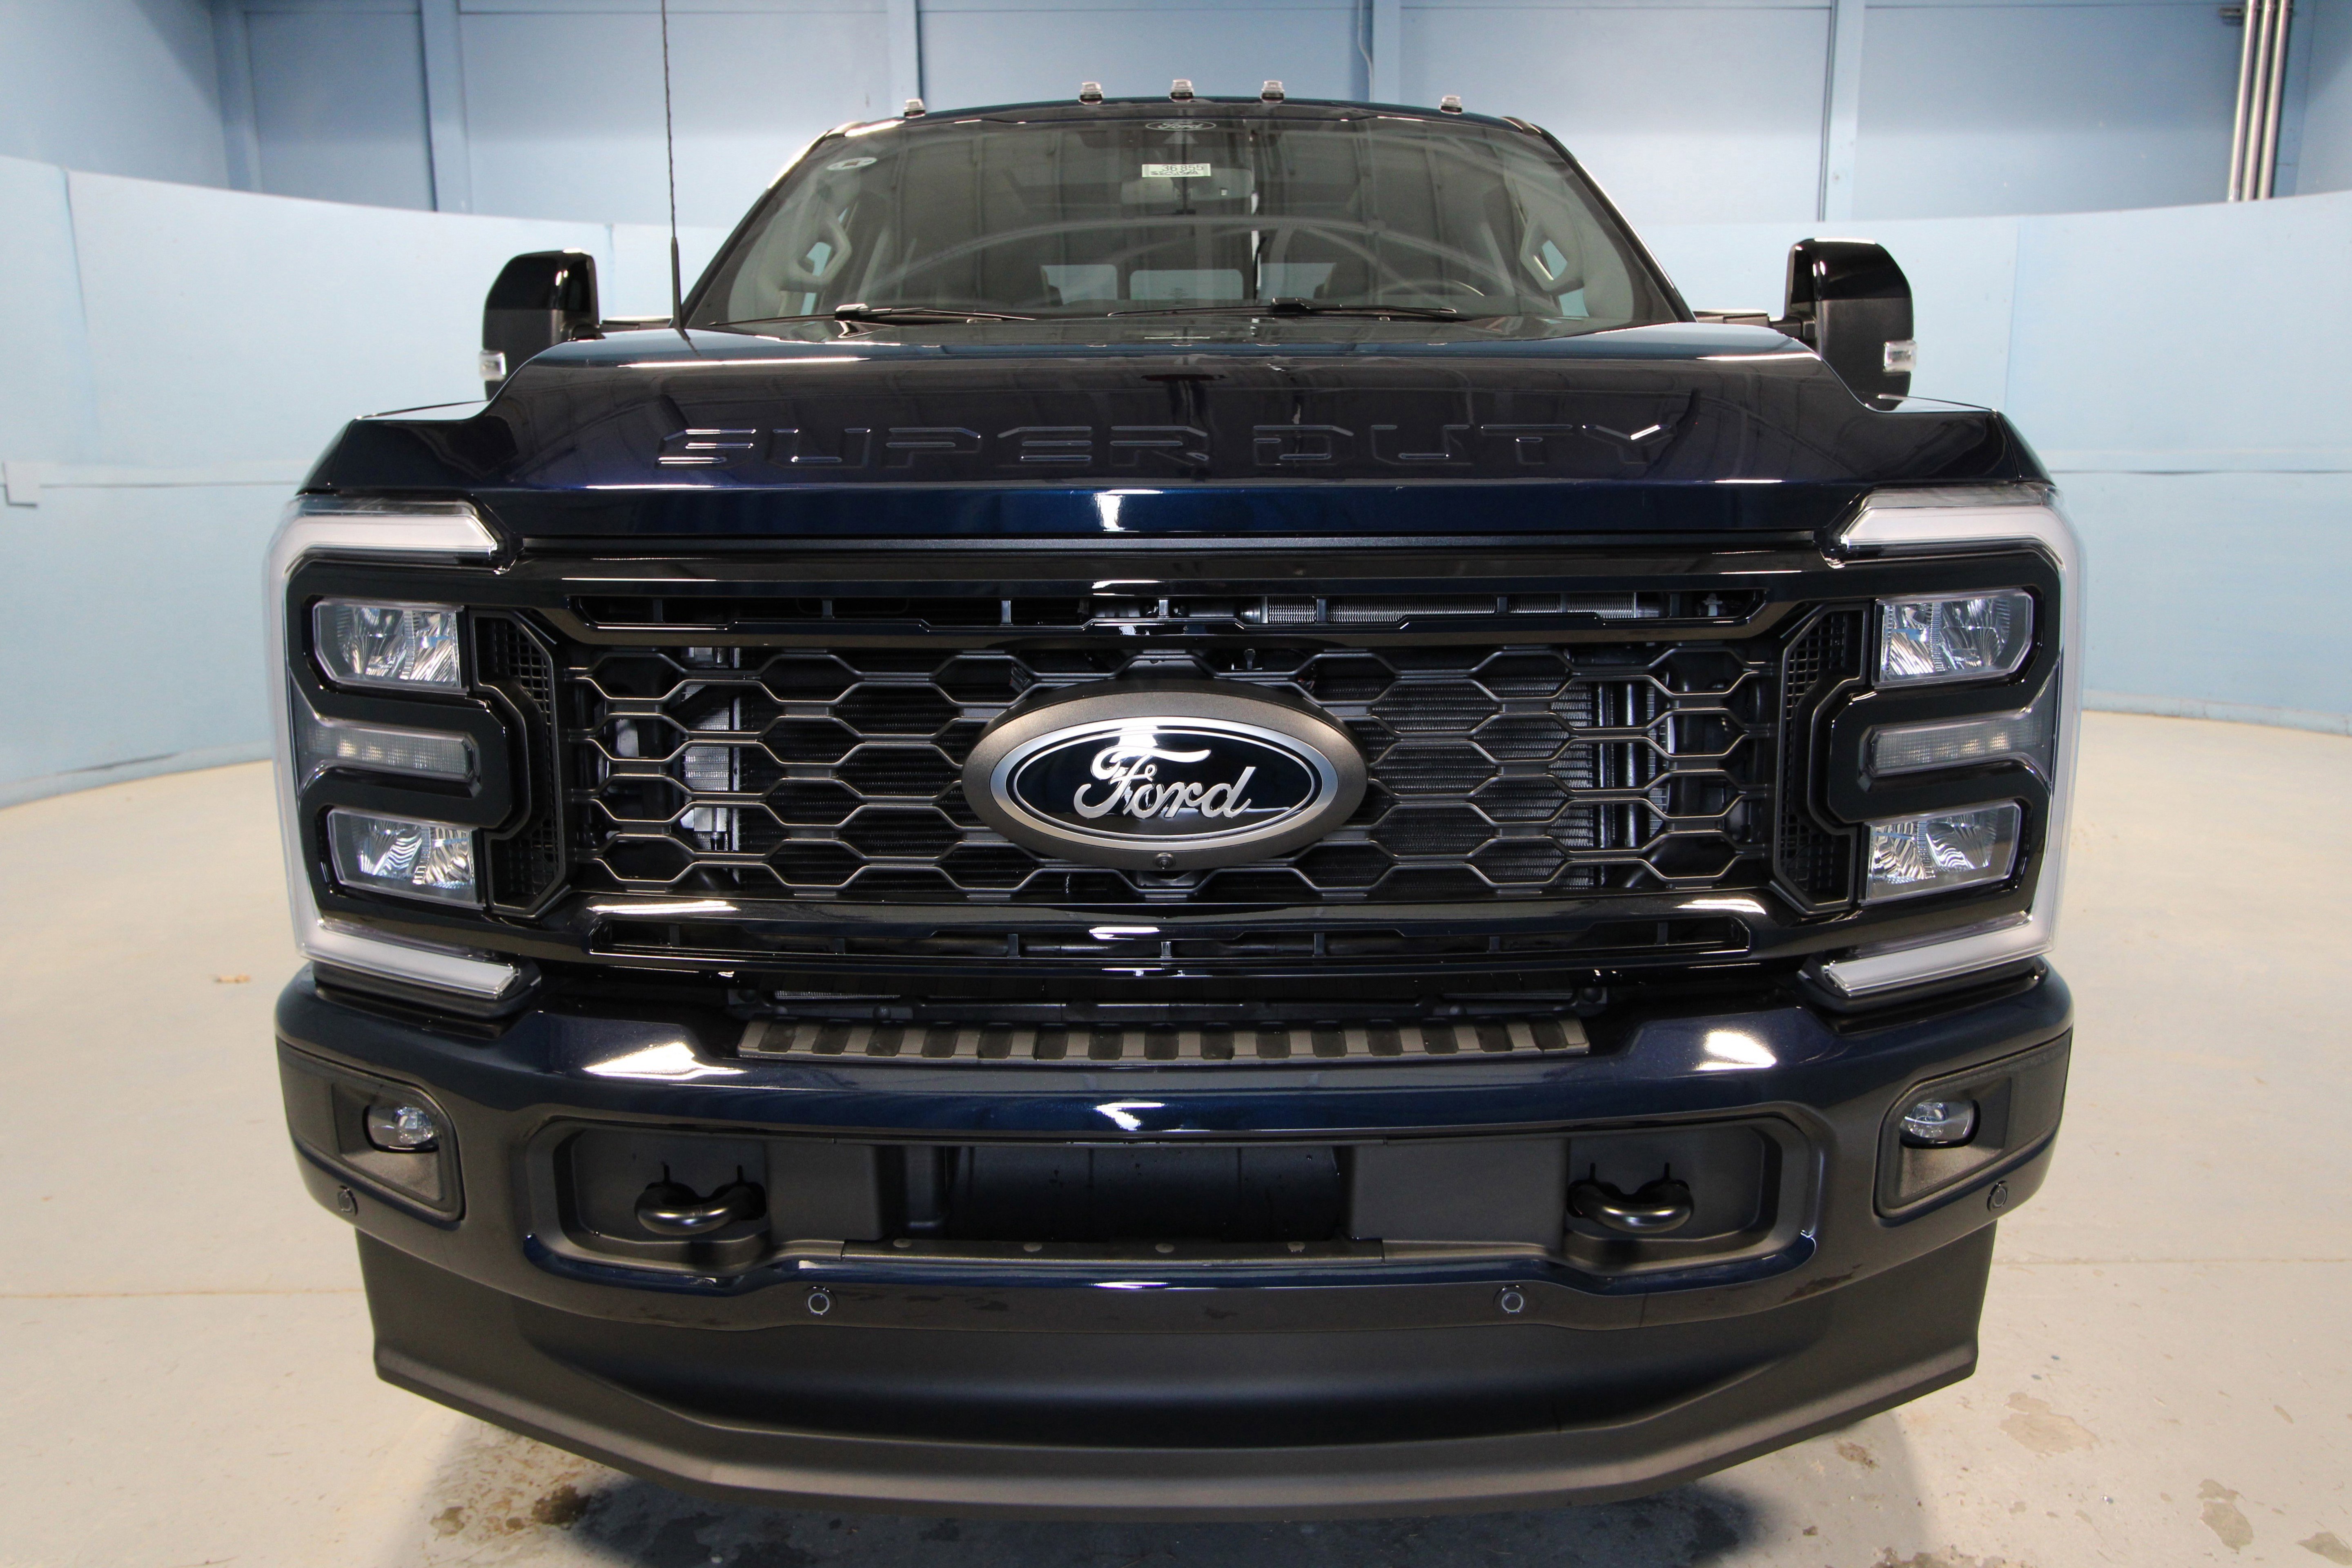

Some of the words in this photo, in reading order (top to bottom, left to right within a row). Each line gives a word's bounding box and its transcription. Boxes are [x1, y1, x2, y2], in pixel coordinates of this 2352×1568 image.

[1158, 120, 1204, 129] Ford
[656, 426, 1209, 468] SUPER
[1253, 424, 1673, 465] DUTY
[1074, 746, 1256, 819] Ford
